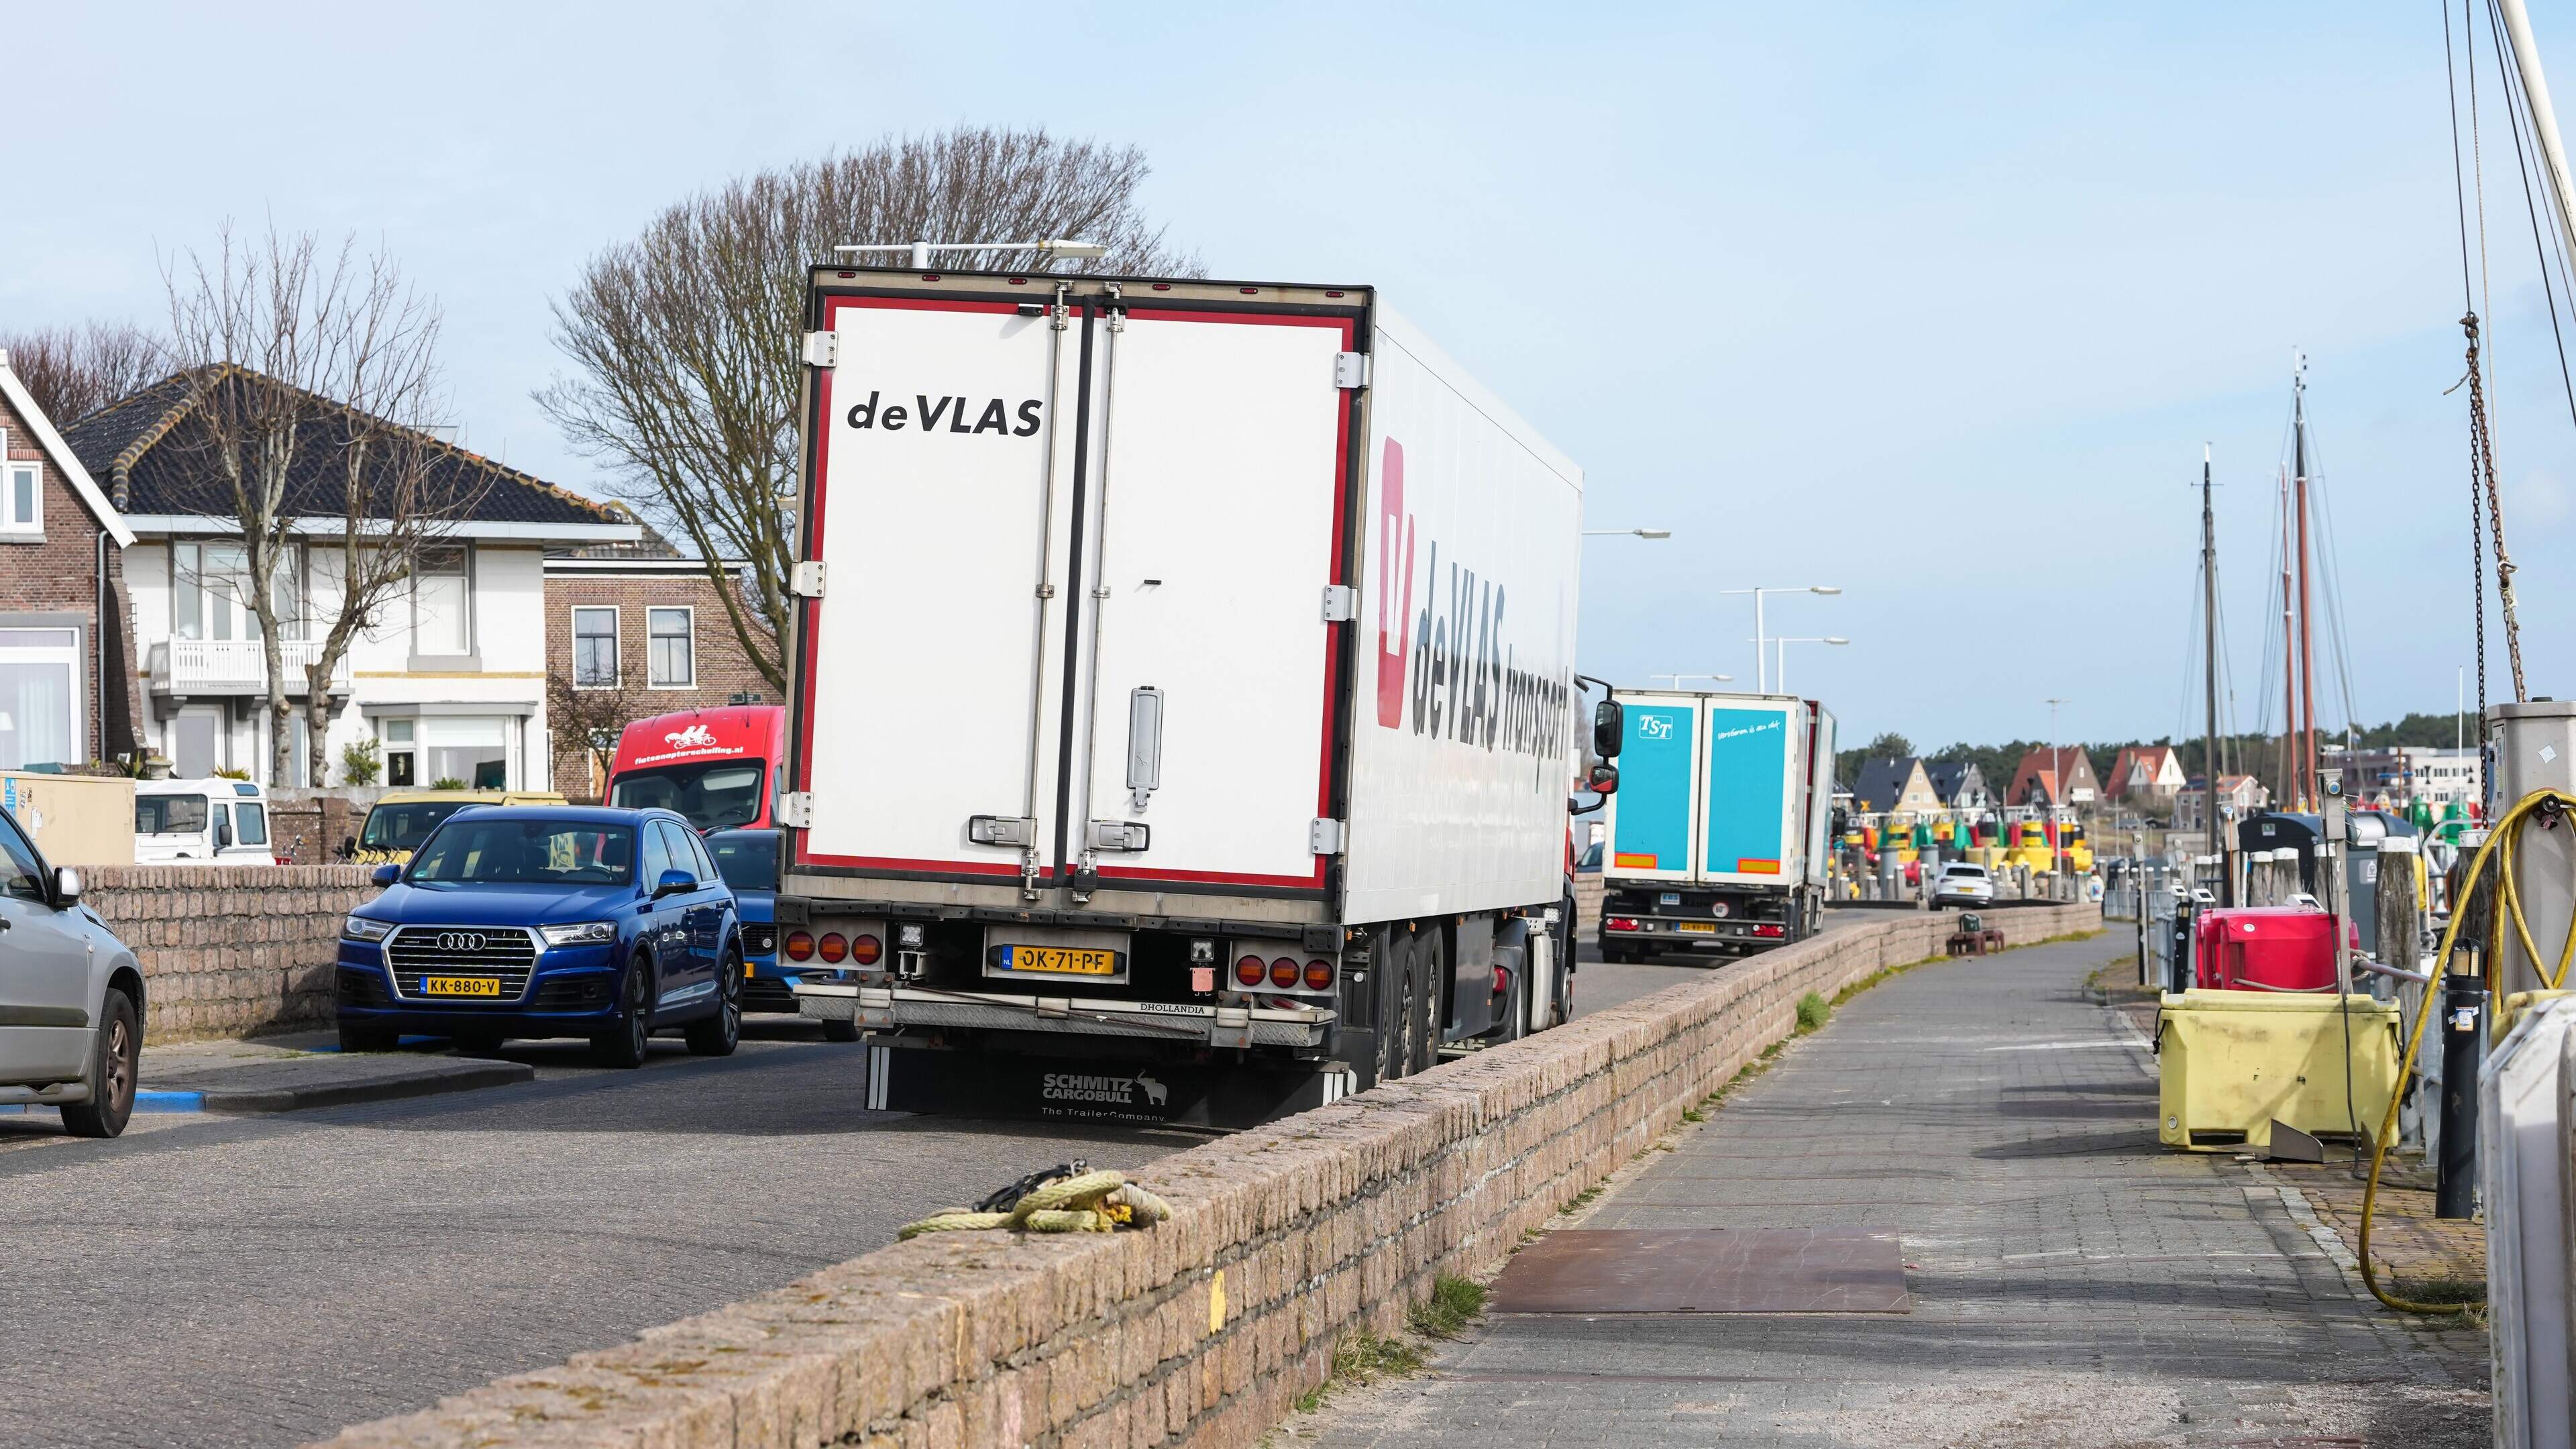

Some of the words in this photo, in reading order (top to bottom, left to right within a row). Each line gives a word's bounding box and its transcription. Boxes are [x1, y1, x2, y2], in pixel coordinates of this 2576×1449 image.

[1502, 643, 1568, 794] transport
[1641, 716, 1672, 739] TST
[635, 746, 744, 765] fietsenopterschelling.nl
[1022, 950, 1105, 970] OK-71-PF
[431, 979, 495, 994] KK-880-V
[1140, 1002, 1205, 1015] DHOLLANDIA
[1043, 1073, 1133, 1093] SCHMITZ
[1042, 1087, 1132, 1104] CARGOBULL
[1041, 1107, 1063, 1116] The
